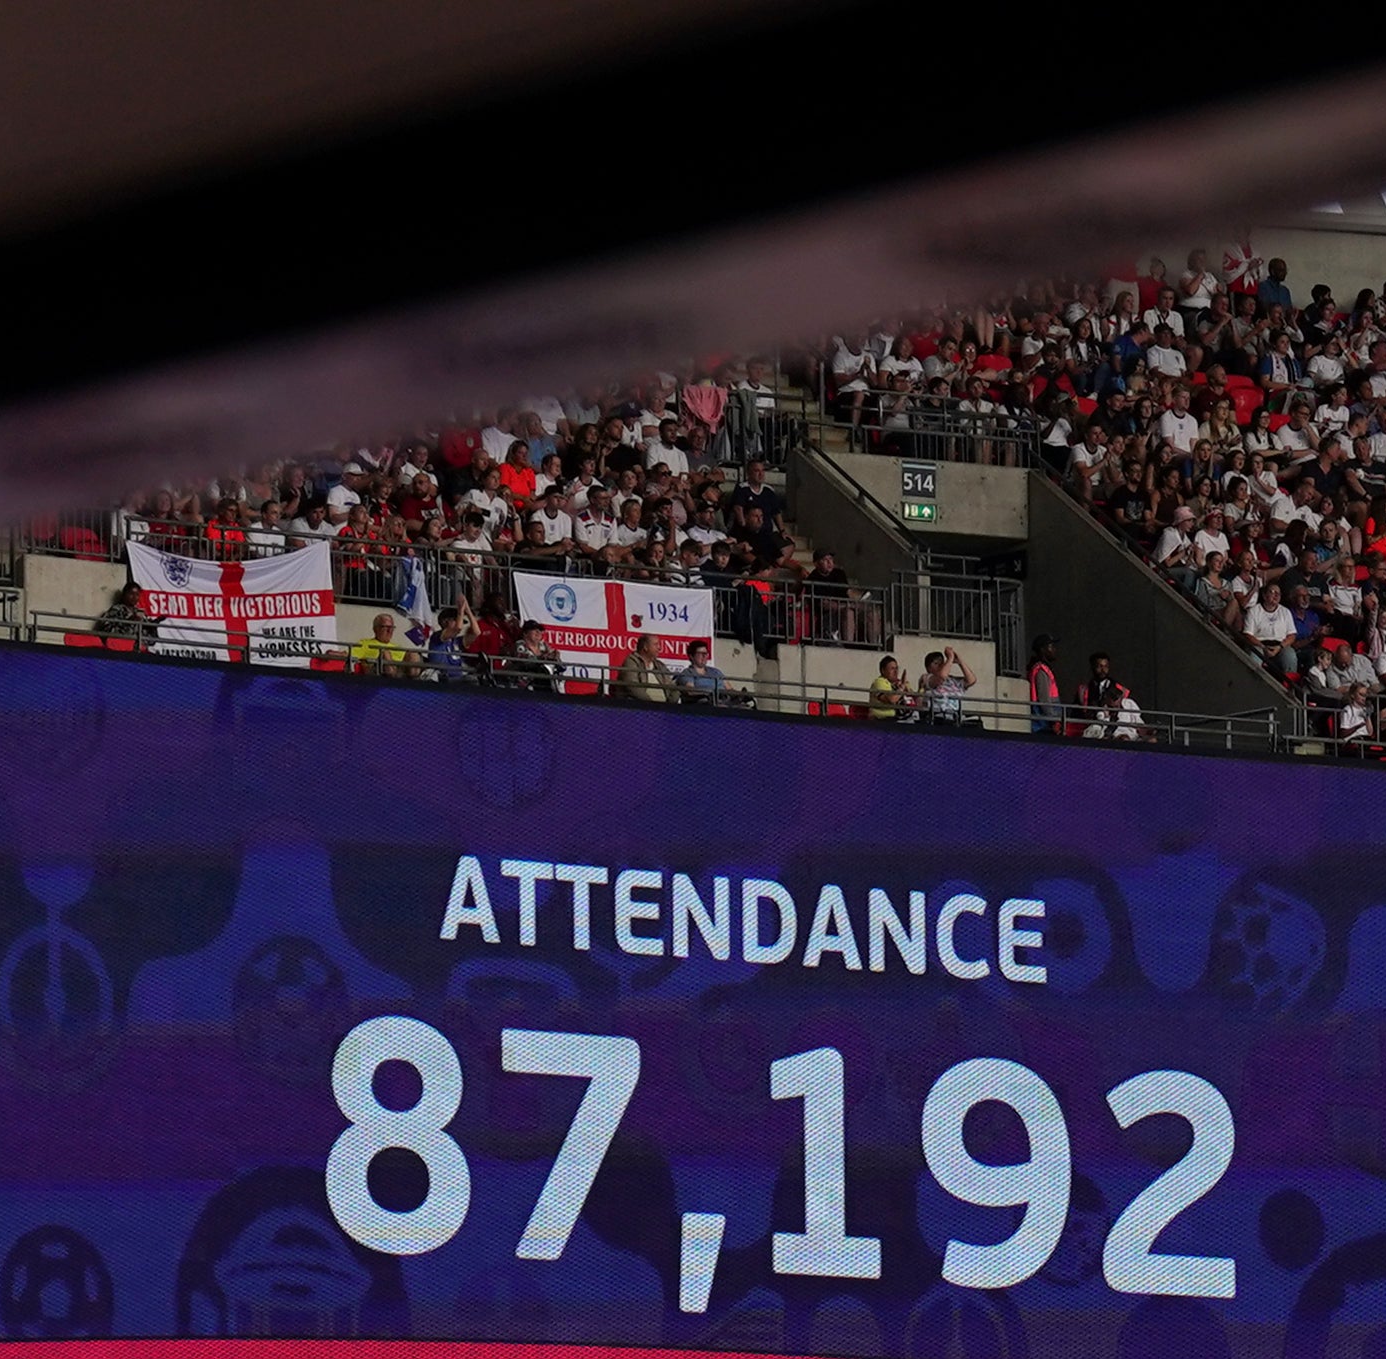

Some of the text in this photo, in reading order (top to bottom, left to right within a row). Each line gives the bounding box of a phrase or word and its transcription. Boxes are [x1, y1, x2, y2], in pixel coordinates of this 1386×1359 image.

[903, 472, 935, 493] 514
[148, 592, 322, 618] SEND HER VICTORIOUS
[647, 601, 690, 623] 1934
[545, 630, 638, 651] TERBOROUG
[440, 855, 1048, 984] ATTENDANCE
[324, 1015, 1237, 1314] 87,192
